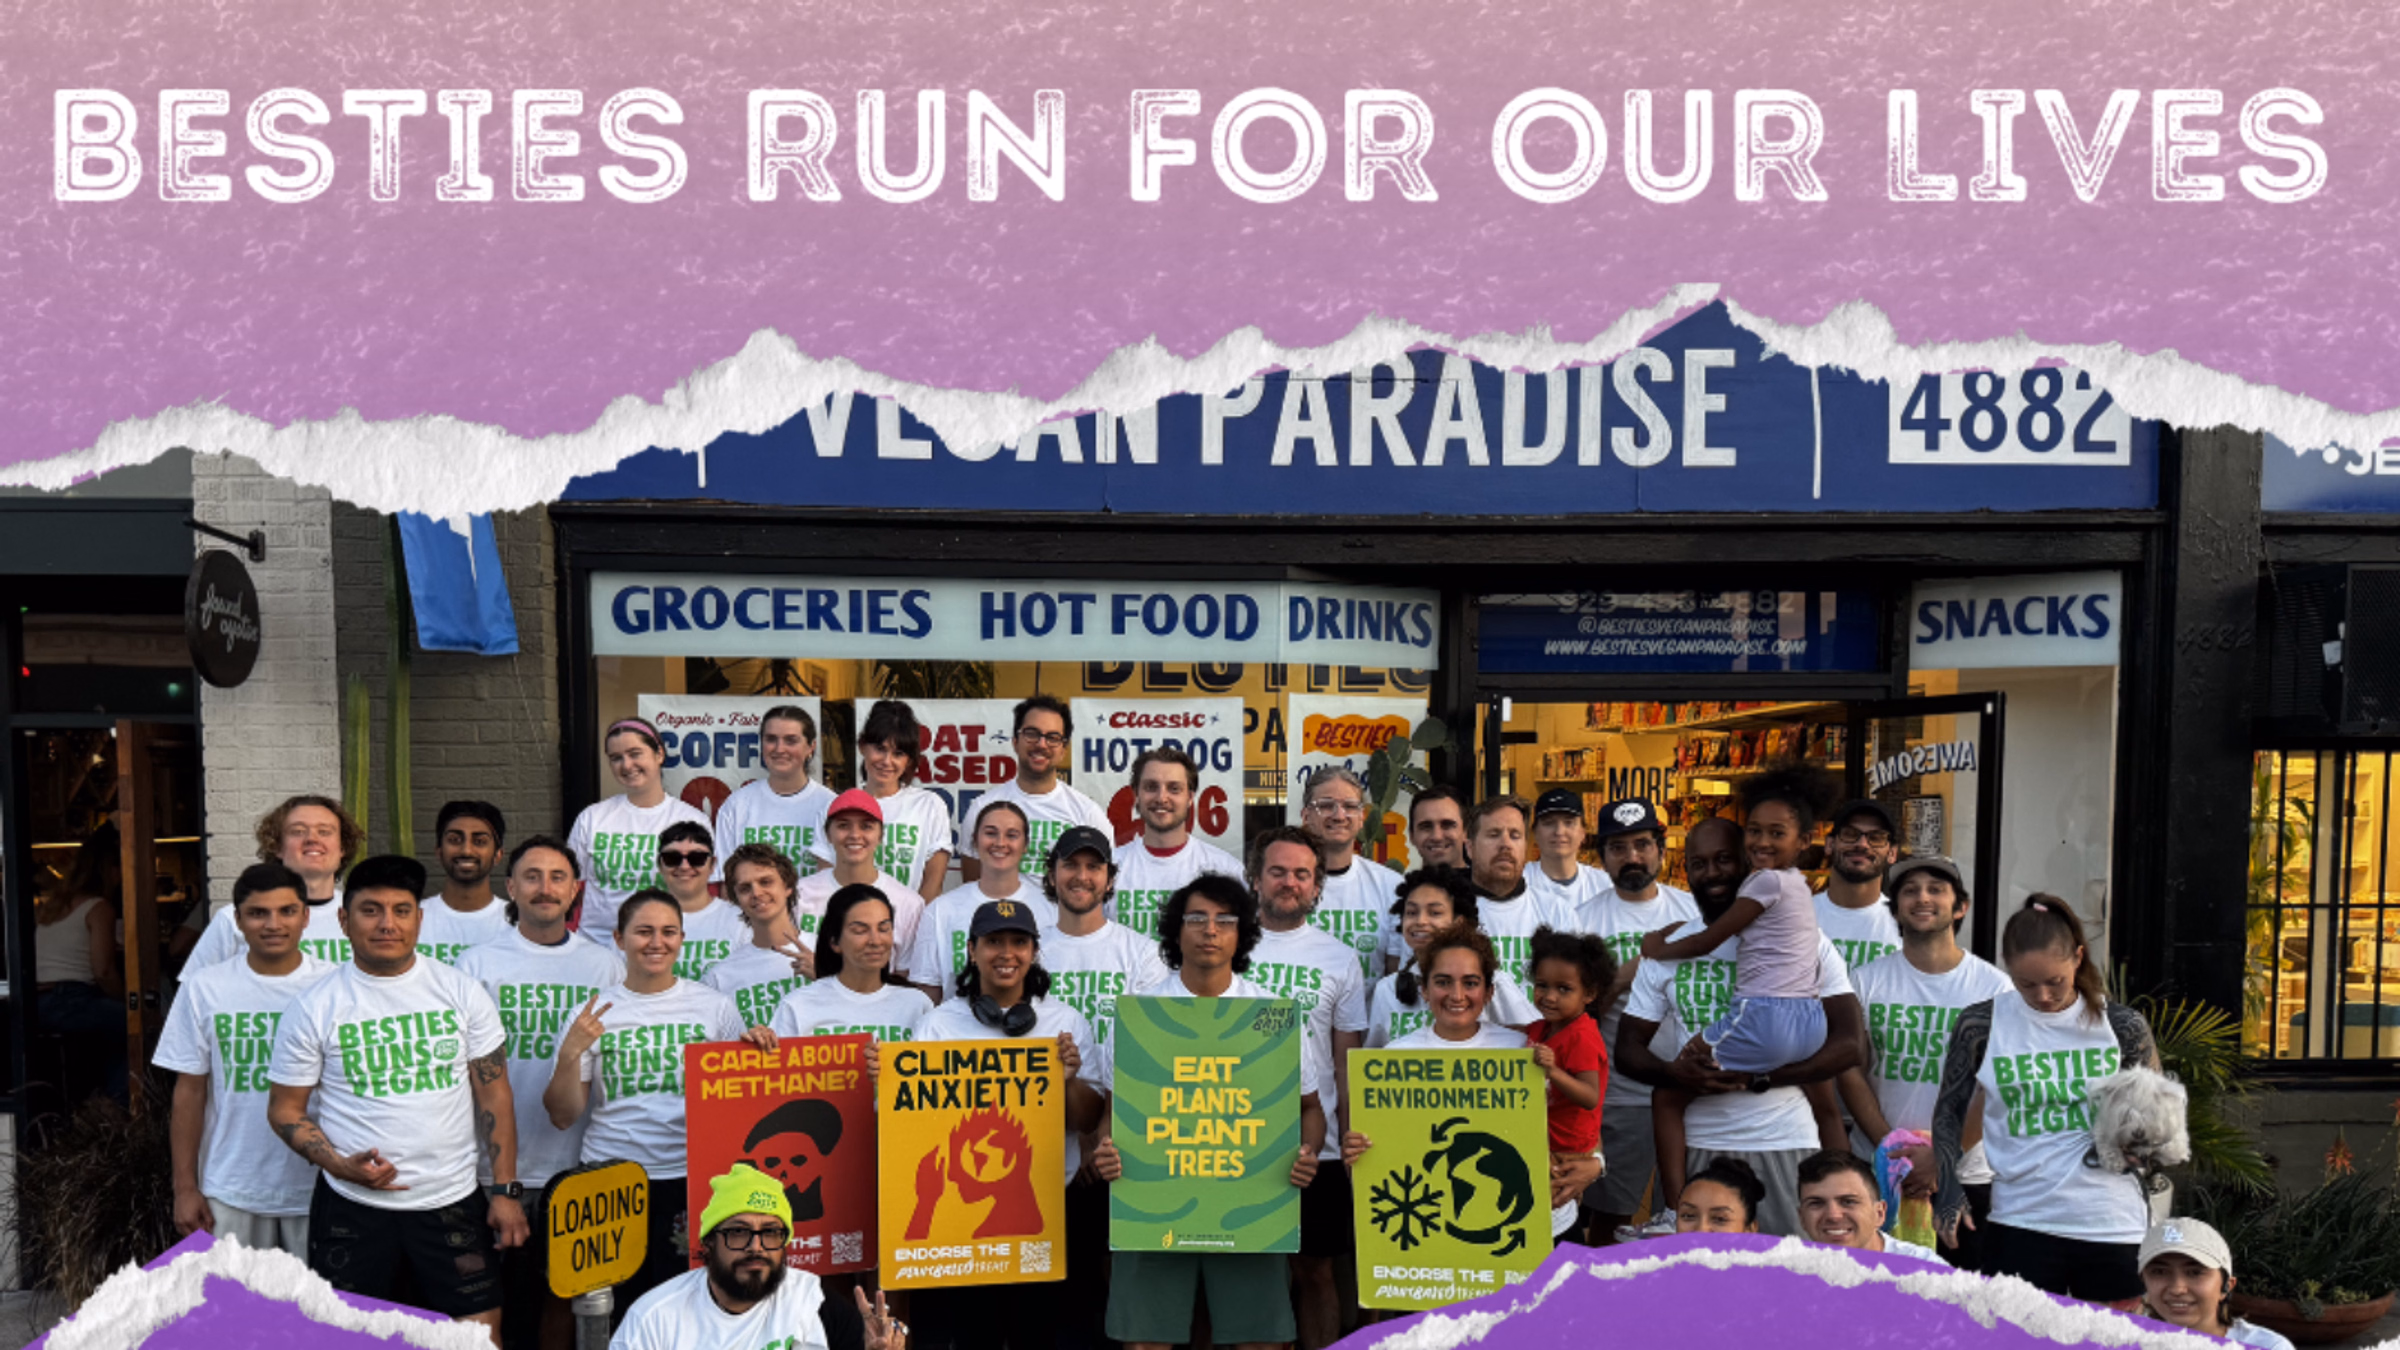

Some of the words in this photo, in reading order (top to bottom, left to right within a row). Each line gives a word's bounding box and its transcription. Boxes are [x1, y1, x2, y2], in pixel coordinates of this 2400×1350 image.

[1201, 346, 1737, 467] PARADISE
[1899, 367, 2117, 454] 4882
[611, 585, 933, 640] GROCERIES
[979, 591, 1097, 641] HOT
[1110, 593, 1260, 642] FOOD
[1288, 595, 1433, 649] DRINKS
[1915, 592, 2111, 644] SNACKS
[655, 711, 715, 729] Organic
[728, 711, 762, 727] Fair
[1108, 711, 1206, 729] Classic
[660, 731, 768, 768] COFF
[1083, 737, 1153, 773] HOT
[594, 832, 661, 851] BESTI
[338, 1009, 460, 1050] BESTIES
[600, 1023, 706, 1053] BESTIES
[340, 1038, 433, 1078] RUNS
[602, 1046, 679, 1076] RUNS
[700, 1048, 781, 1074] CARE
[786, 1043, 859, 1069] ABOUT
[893, 1047, 1049, 1077] CLIMATE
[1172, 1056, 1242, 1084] EAT
[1363, 1058, 1445, 1082] CARE
[1450, 1058, 1528, 1082] ABOUT
[1992, 1046, 2120, 1085] BESTIES
[603, 1072, 685, 1102] VEGA
[701, 1069, 860, 1100] METHANE?
[893, 1076, 1049, 1111] ANXIETY?
[1363, 1087, 1530, 1110] ENVIRONMENT?
[1160, 1086, 1253, 1115] PLANTS
[1146, 1117, 1267, 1145] PLANT
[1164, 1149, 1246, 1178] TREES
[552, 1183, 645, 1238] LOADING
[571, 1226, 625, 1273] ONLY
[895, 1245, 973, 1262] ENDORSE
[977, 1243, 1011, 1256] THE
[1373, 1265, 1454, 1282] ENDORSE
[1458, 1269, 1495, 1283] THE
